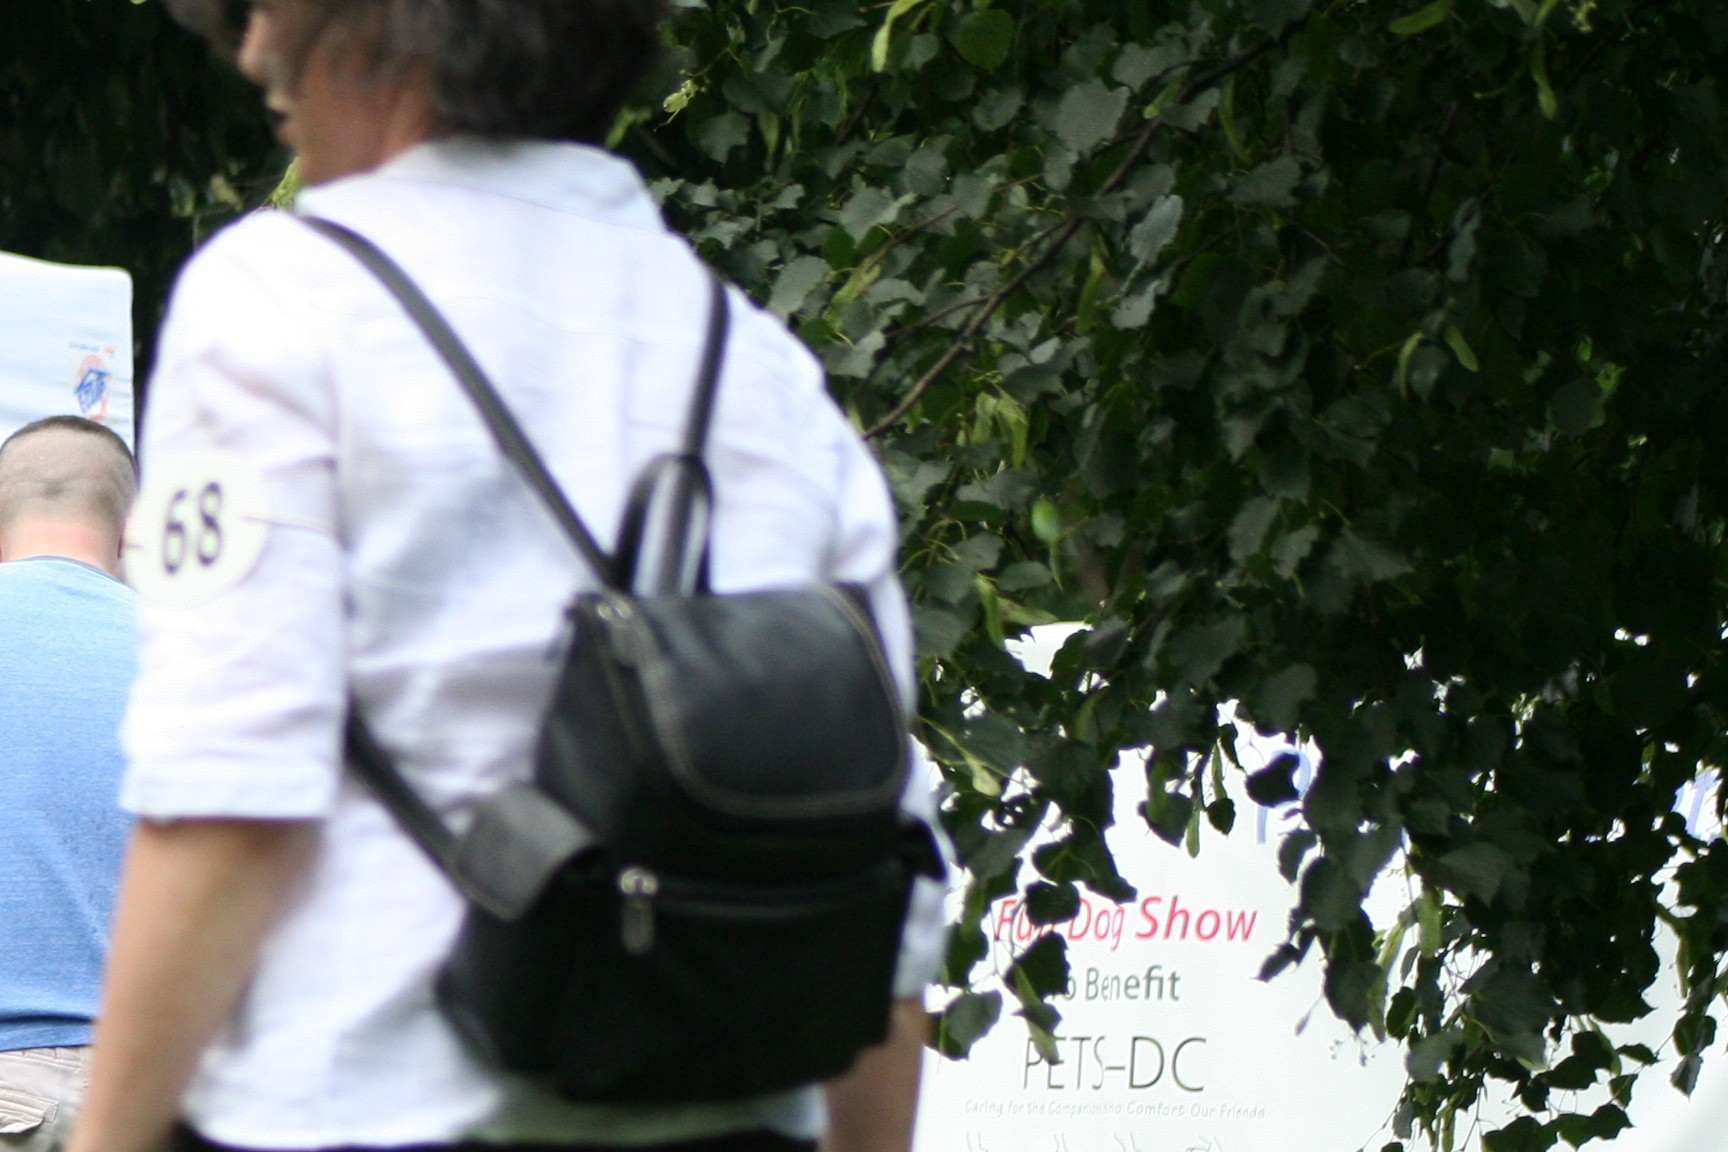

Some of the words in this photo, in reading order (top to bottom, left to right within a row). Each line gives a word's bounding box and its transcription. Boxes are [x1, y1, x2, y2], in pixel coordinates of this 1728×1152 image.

[163, 481, 222, 575] 68
[1134, 894, 1259, 943] Show
[1085, 965, 1181, 1002] Benefit
[1023, 1034, 1208, 1093] PETS-DC
[964, 1100, 1003, 1118] Caring
[1190, 1102, 1216, 1118] Our
